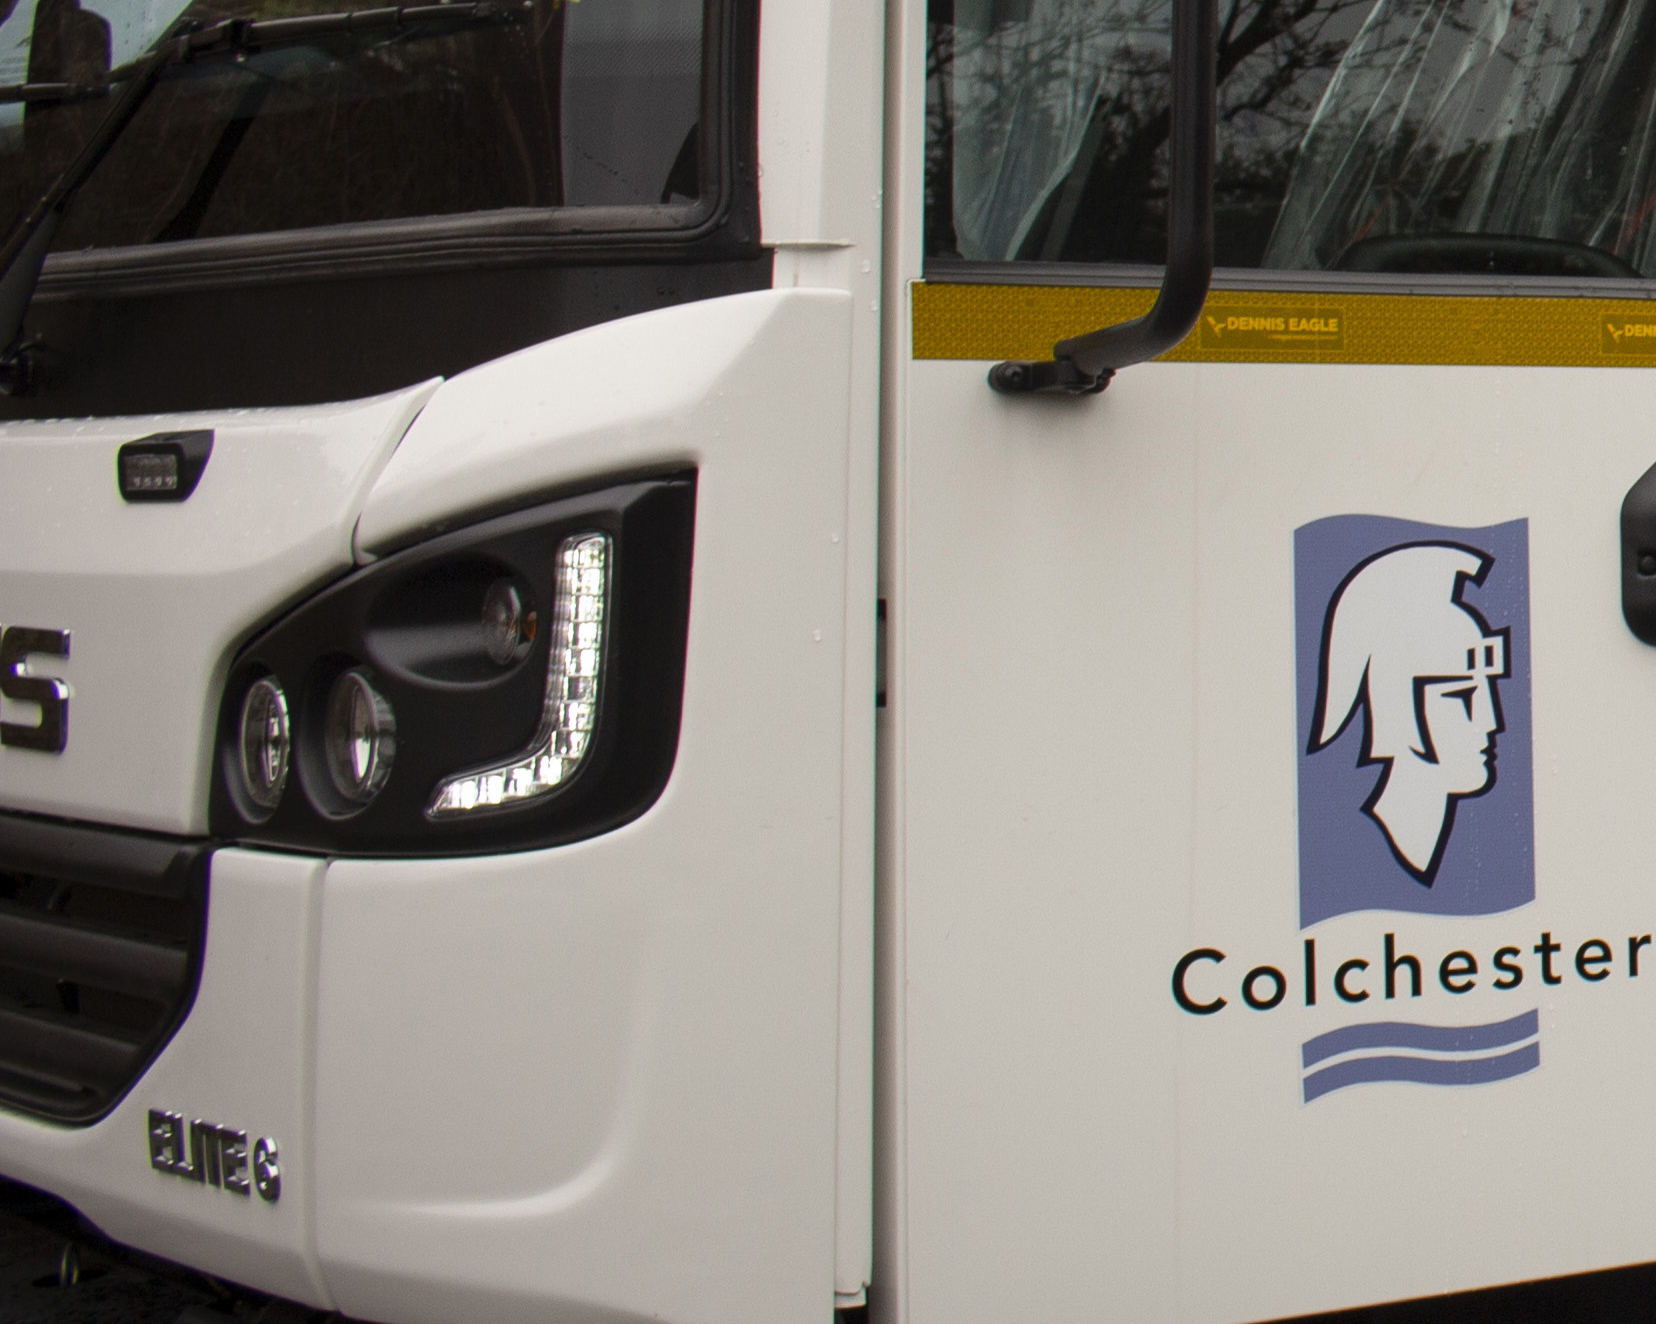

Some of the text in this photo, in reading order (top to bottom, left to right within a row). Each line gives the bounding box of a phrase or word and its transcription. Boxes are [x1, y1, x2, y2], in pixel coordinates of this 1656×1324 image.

[1227, 316, 1339, 332] DENNIS EAGLE
[1171, 931, 1653, 1016] Colchester
[148, 1109, 251, 1197] ELITE
